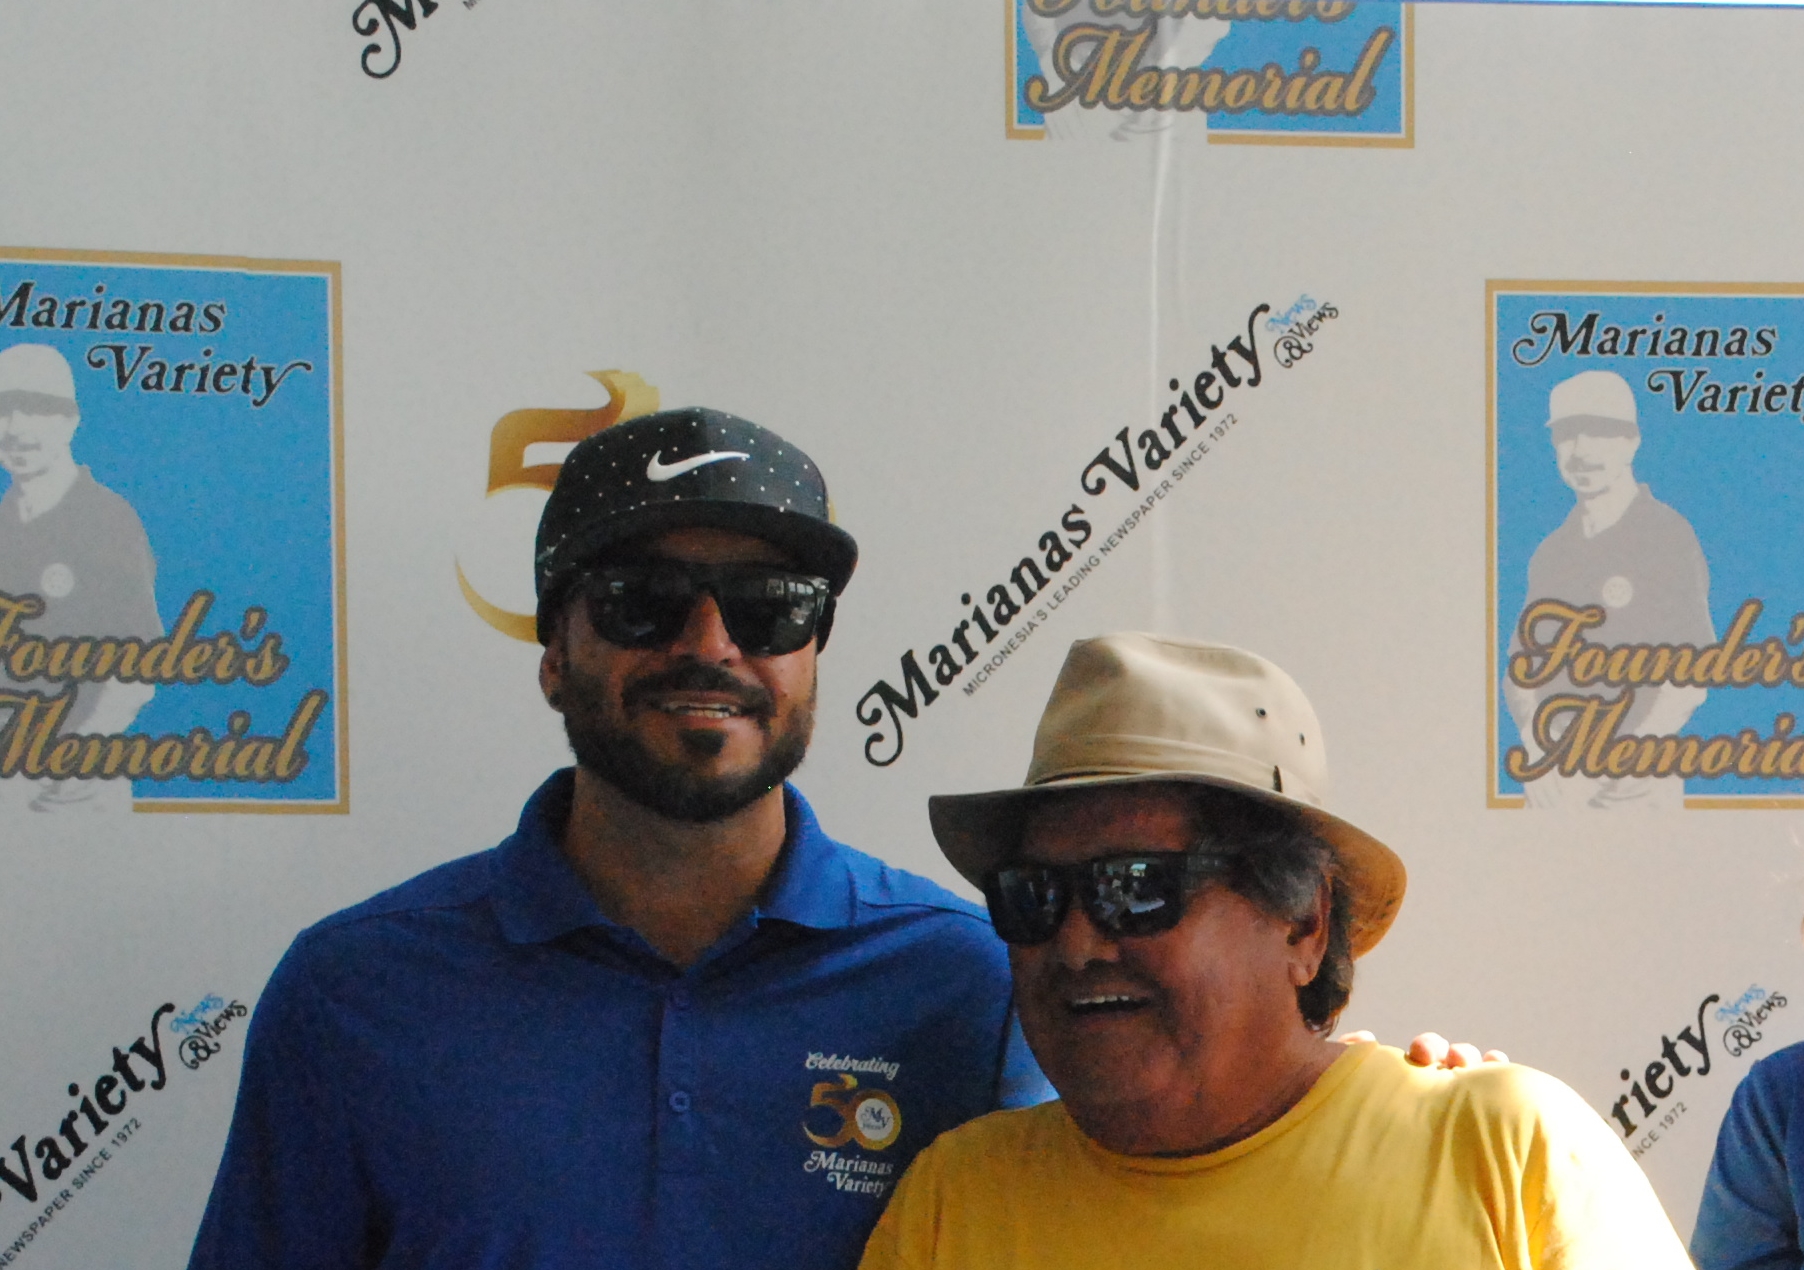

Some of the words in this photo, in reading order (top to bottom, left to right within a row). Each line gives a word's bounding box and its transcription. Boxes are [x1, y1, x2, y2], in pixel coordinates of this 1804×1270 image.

[1025, 17, 1396, 116] Memorial
[1265, 293, 1317, 334] News
[1289, 300, 1339, 341] Views
[1512, 311, 1777, 366] Marianas
[87, 345, 311, 406] Variety
[856, 503, 1092, 766] Marianas
[1081, 302, 1270, 496] Variety
[963, 608, 1048, 698] MICRONESIA'S
[1046, 555, 1100, 612] LEADING
[1099, 479, 1173, 557] NEWSPAPER
[1172, 442, 1210, 483] SINCE
[1210, 413, 1239, 443] 1972
[196, 1000, 248, 1040] Views
[1715, 984, 1766, 1023] News
[1738, 991, 1788, 1029] Views
[805, 1051, 900, 1081] Celebrating
[1611, 993, 1720, 1138] riety
[803, 1073, 902, 1150] 50
[1659, 1101, 1688, 1131] 1972
[804, 1150, 894, 1173] Marianas
[0, 1188, 73, 1270] NEWSPAPER
[72, 1147, 112, 1190] SINCE
[111, 1117, 142, 1148] 1972
[827, 1171, 890, 1198] Variety
